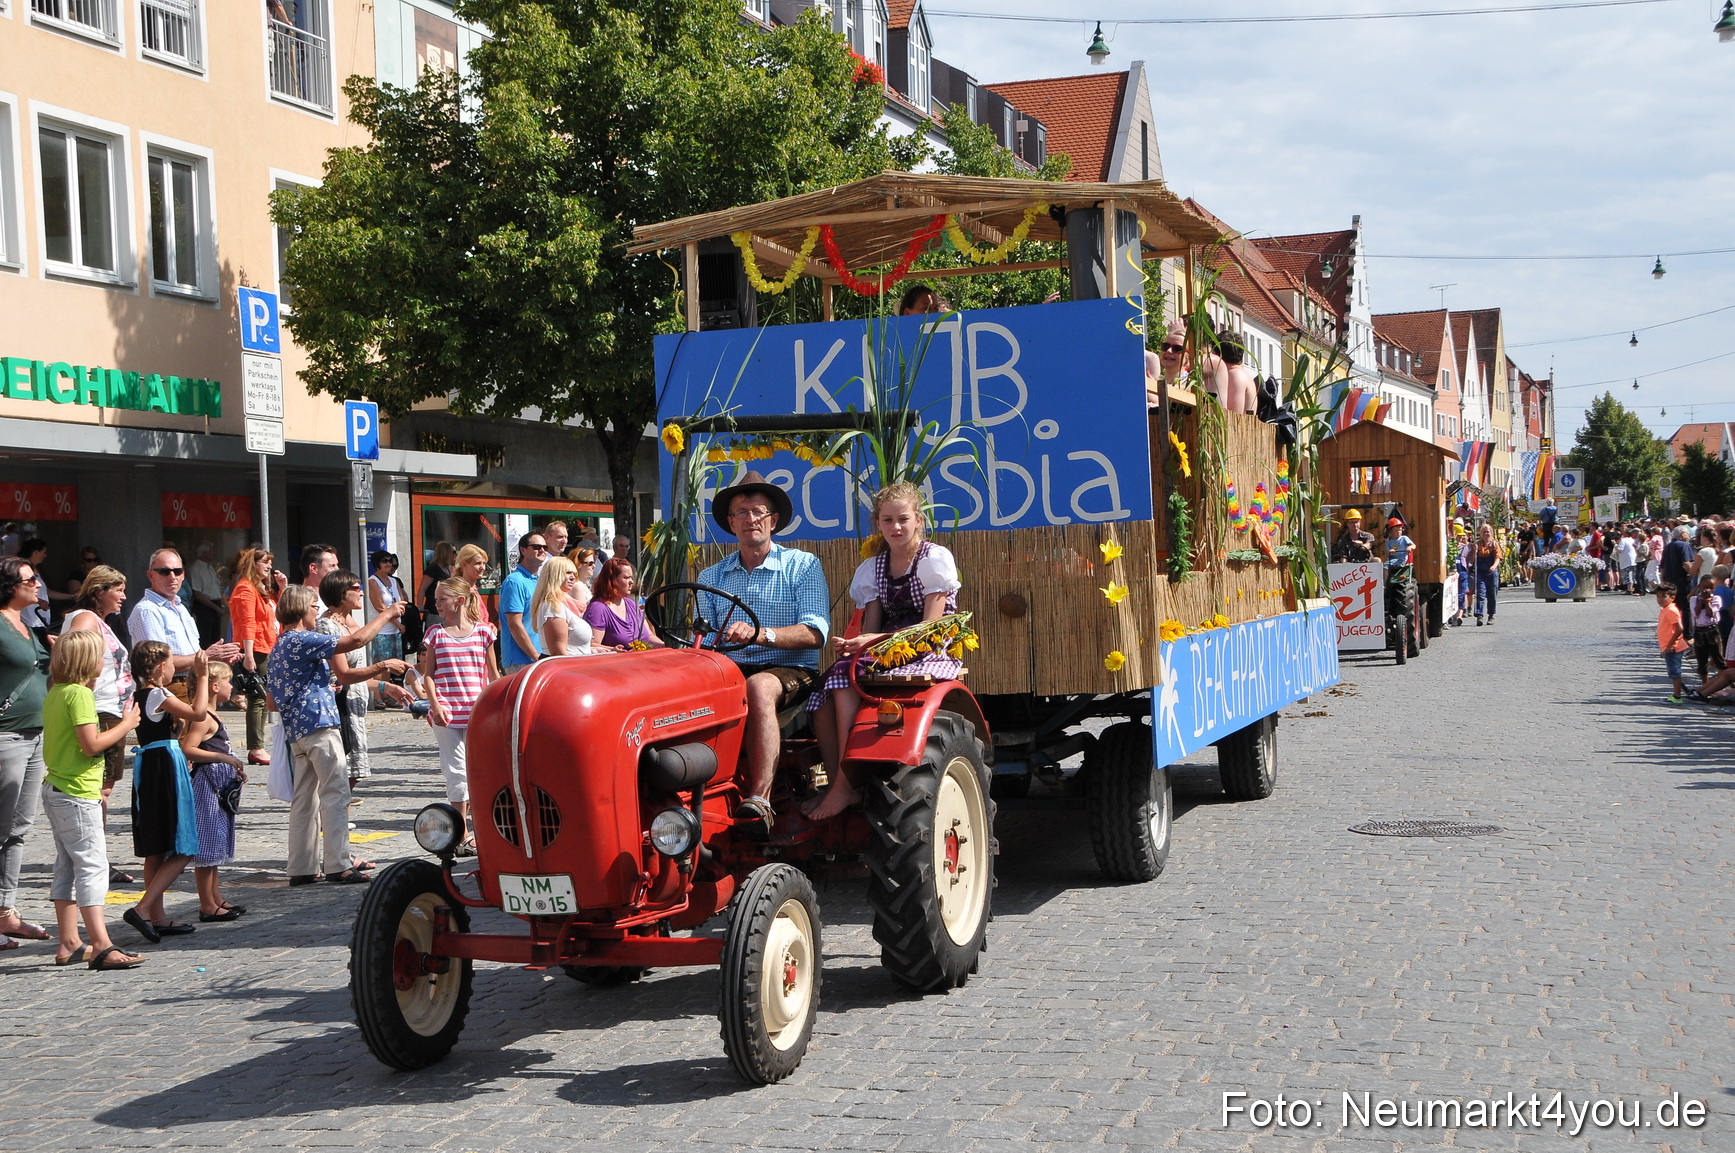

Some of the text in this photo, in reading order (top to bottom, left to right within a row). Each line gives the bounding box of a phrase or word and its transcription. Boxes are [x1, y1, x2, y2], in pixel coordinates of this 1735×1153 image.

[248, 296, 270, 342] P
[248, 370, 278, 382] Parkschein
[0, 356, 222, 418] EICHMANN
[251, 382, 276, 393] werktags
[248, 401, 255, 410] Sa
[352, 408, 371, 452] P
[1190, 619, 1281, 738] BEACHPARTY
[521, 878, 552, 894] NM
[508, 895, 567, 912] DY 15
